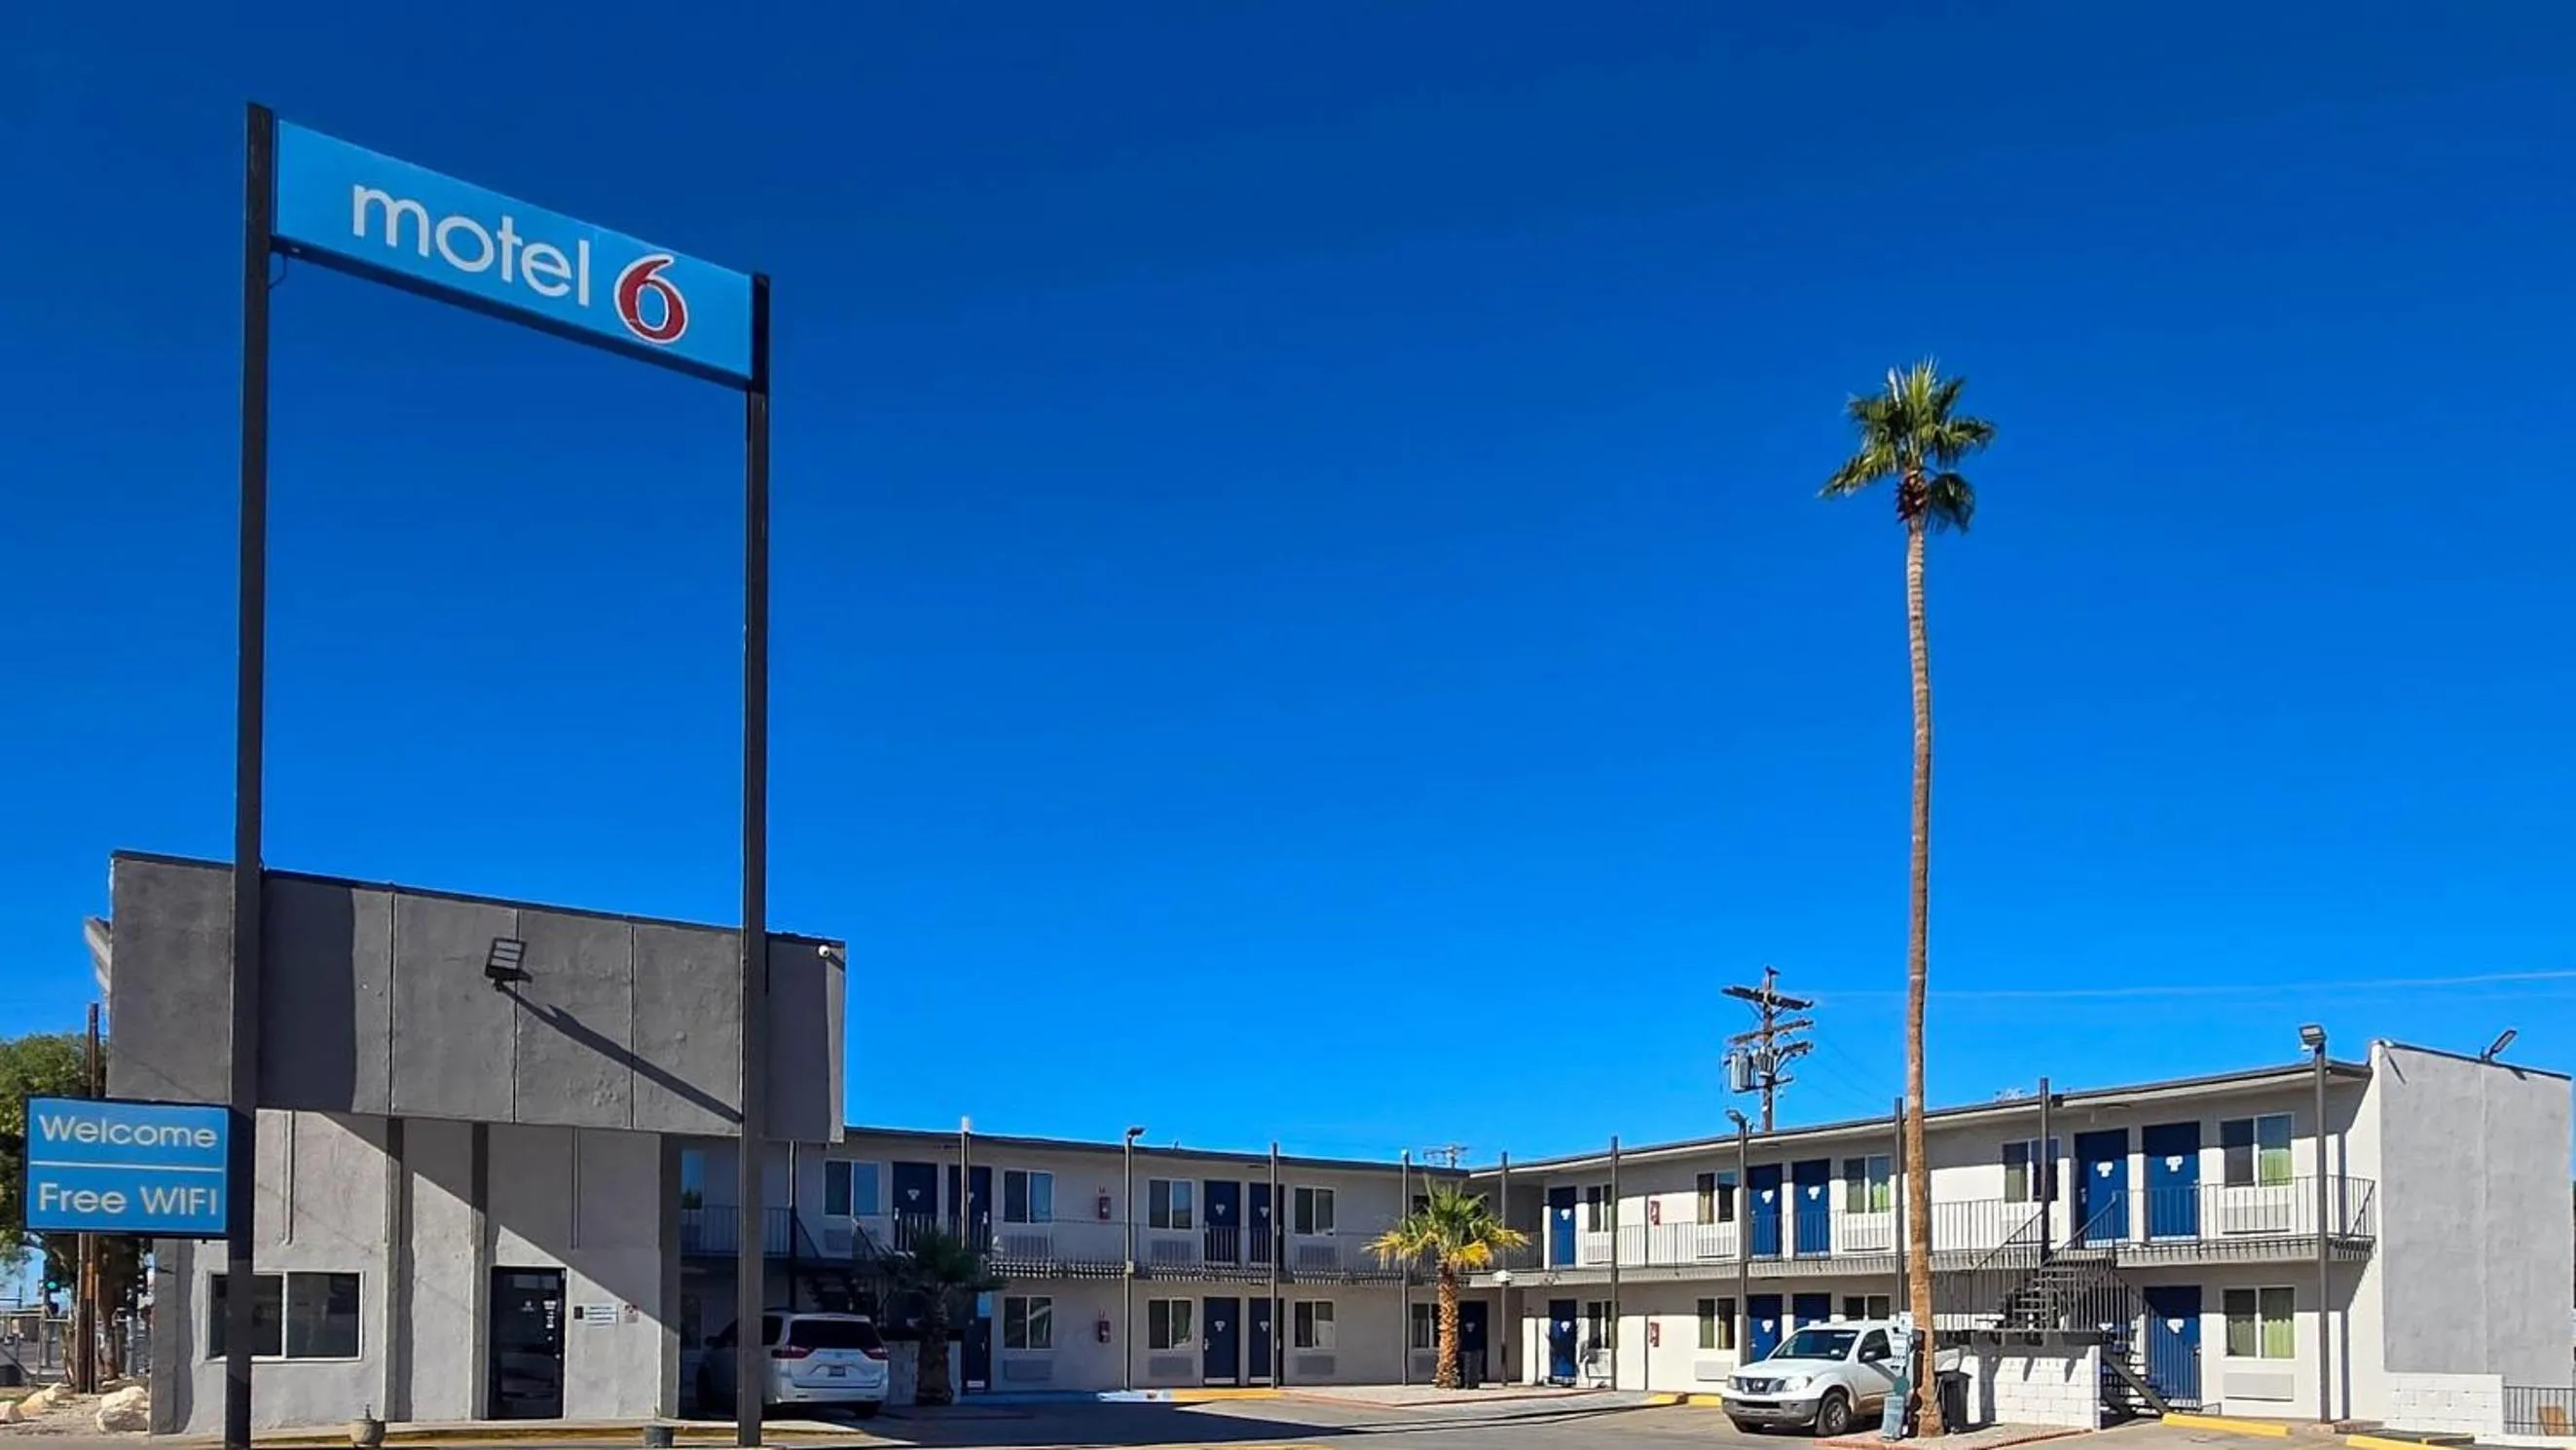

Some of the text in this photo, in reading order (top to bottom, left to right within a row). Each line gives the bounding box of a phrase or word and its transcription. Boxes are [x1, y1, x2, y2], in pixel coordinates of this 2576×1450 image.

[352, 184, 688, 344] motel 6
[39, 1114, 218, 1148] Welcome
[39, 1182, 217, 1215] Free WIFI
